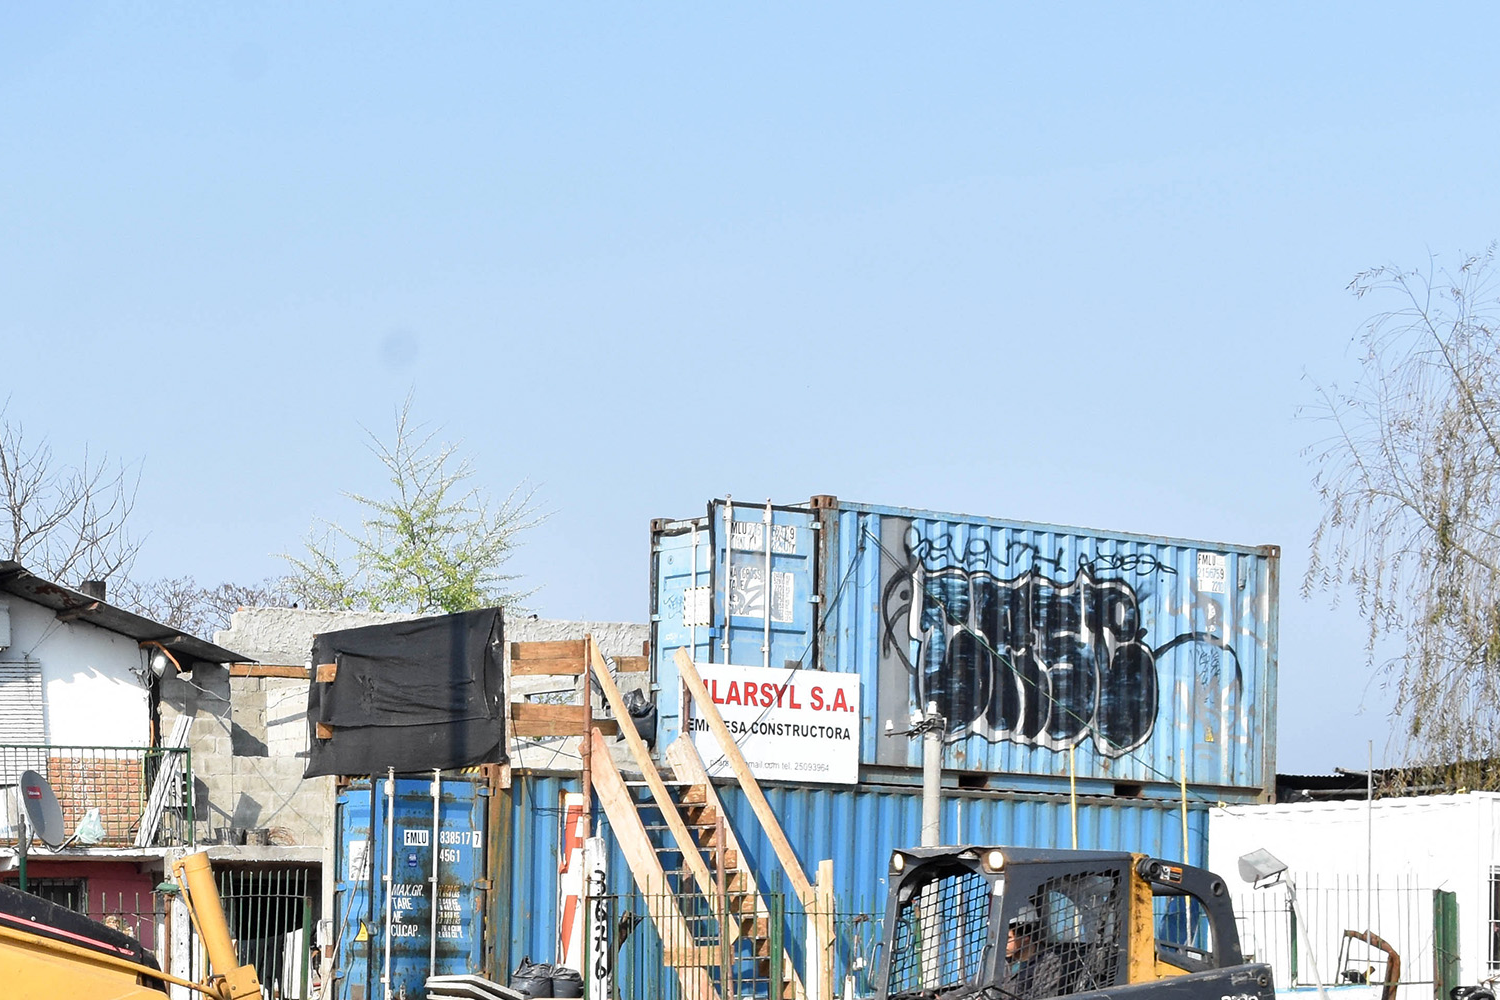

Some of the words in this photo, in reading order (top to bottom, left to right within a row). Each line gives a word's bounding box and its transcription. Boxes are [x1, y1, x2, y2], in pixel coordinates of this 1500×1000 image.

[810, 686, 855, 713] S.A.
[751, 721, 851, 741] CONSTRUCTORA
[405, 831, 428, 844] FMLU
[440, 830, 471, 845] 838517
[392, 897, 414, 910] TARE
